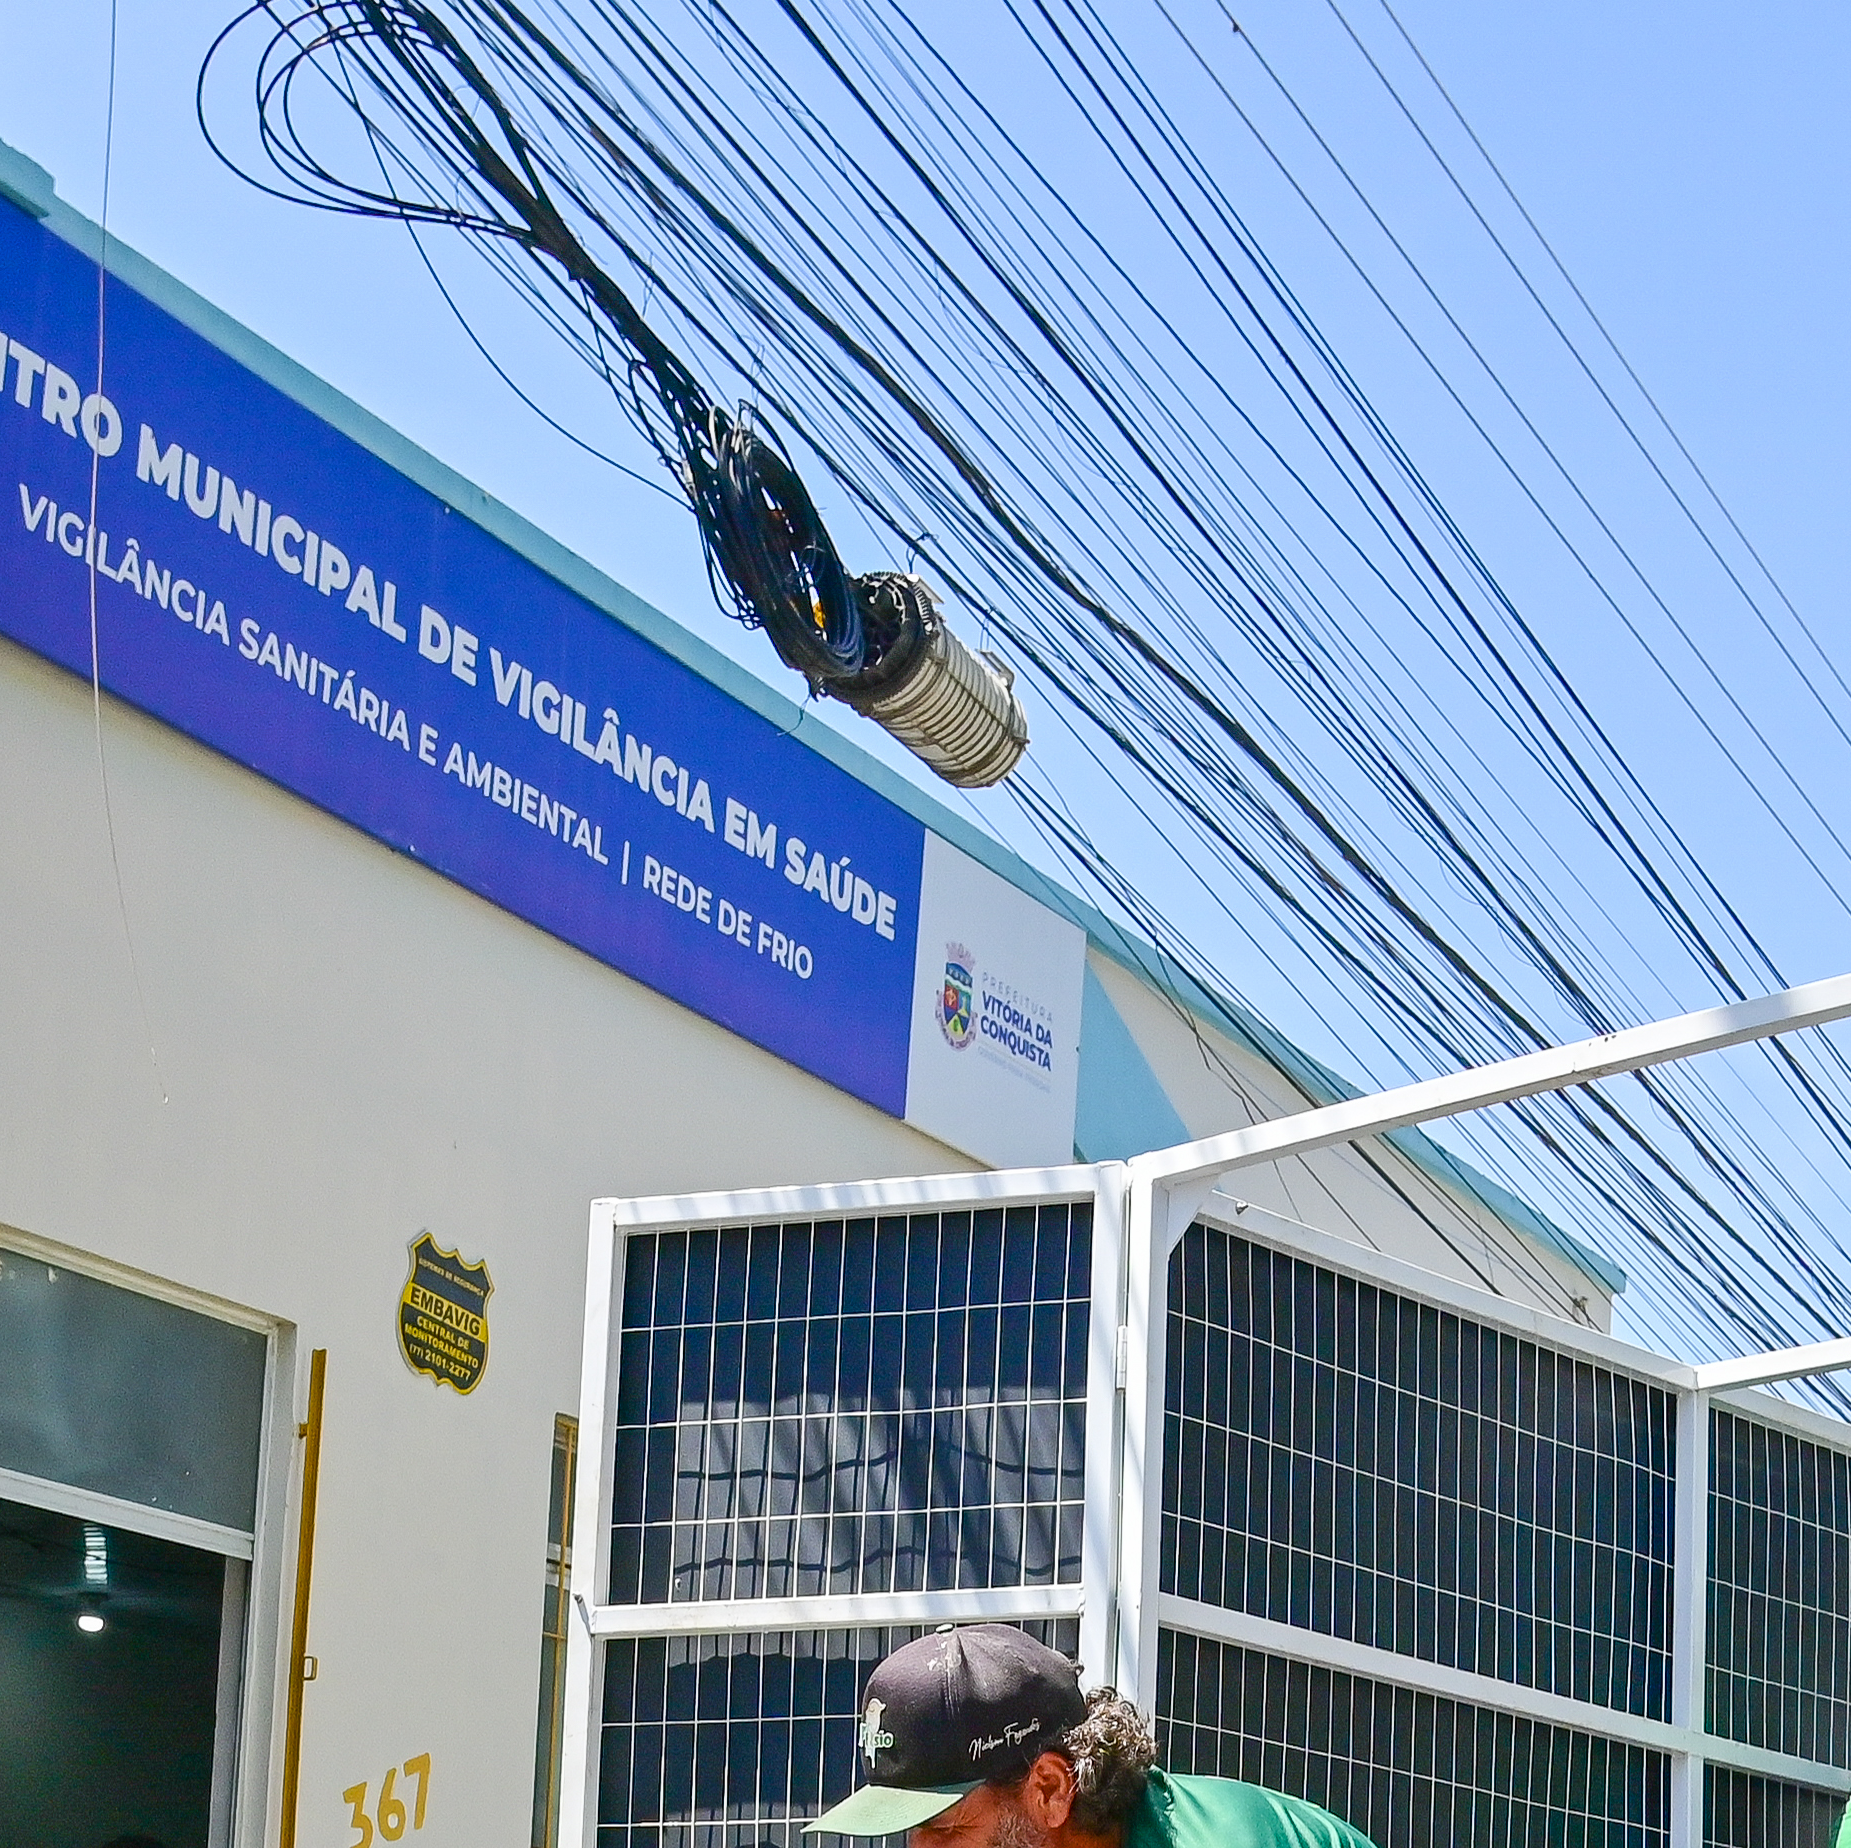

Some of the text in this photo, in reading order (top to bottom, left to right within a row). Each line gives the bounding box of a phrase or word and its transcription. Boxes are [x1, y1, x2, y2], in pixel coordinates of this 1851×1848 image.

[136, 422, 406, 642] MUNICIPAL
[418, 605, 478, 686] DE
[490, 645, 714, 834] VIGILÂNCIA
[724, 796, 776, 869] EM
[785, 855, 897, 942] SAÚDE
[18, 482, 230, 645] VIGILÂNCIA
[239, 617, 411, 752] SANITÁRIA
[418, 722, 438, 766] E
[444, 742, 608, 866] AMBIENTAL
[642, 855, 712, 924] REDE
[717, 897, 751, 947] DE
[757, 922, 814, 980] FRIO
[980, 1014, 1051, 1071] CONQUISTA
[982, 989, 1053, 1049] VITÓRIA DA
[411, 1285, 480, 1335] EMBAVIG
[417, 1315, 469, 1351] CENTRAL DE
[405, 1322, 479, 1369] MONITORAMENTO
